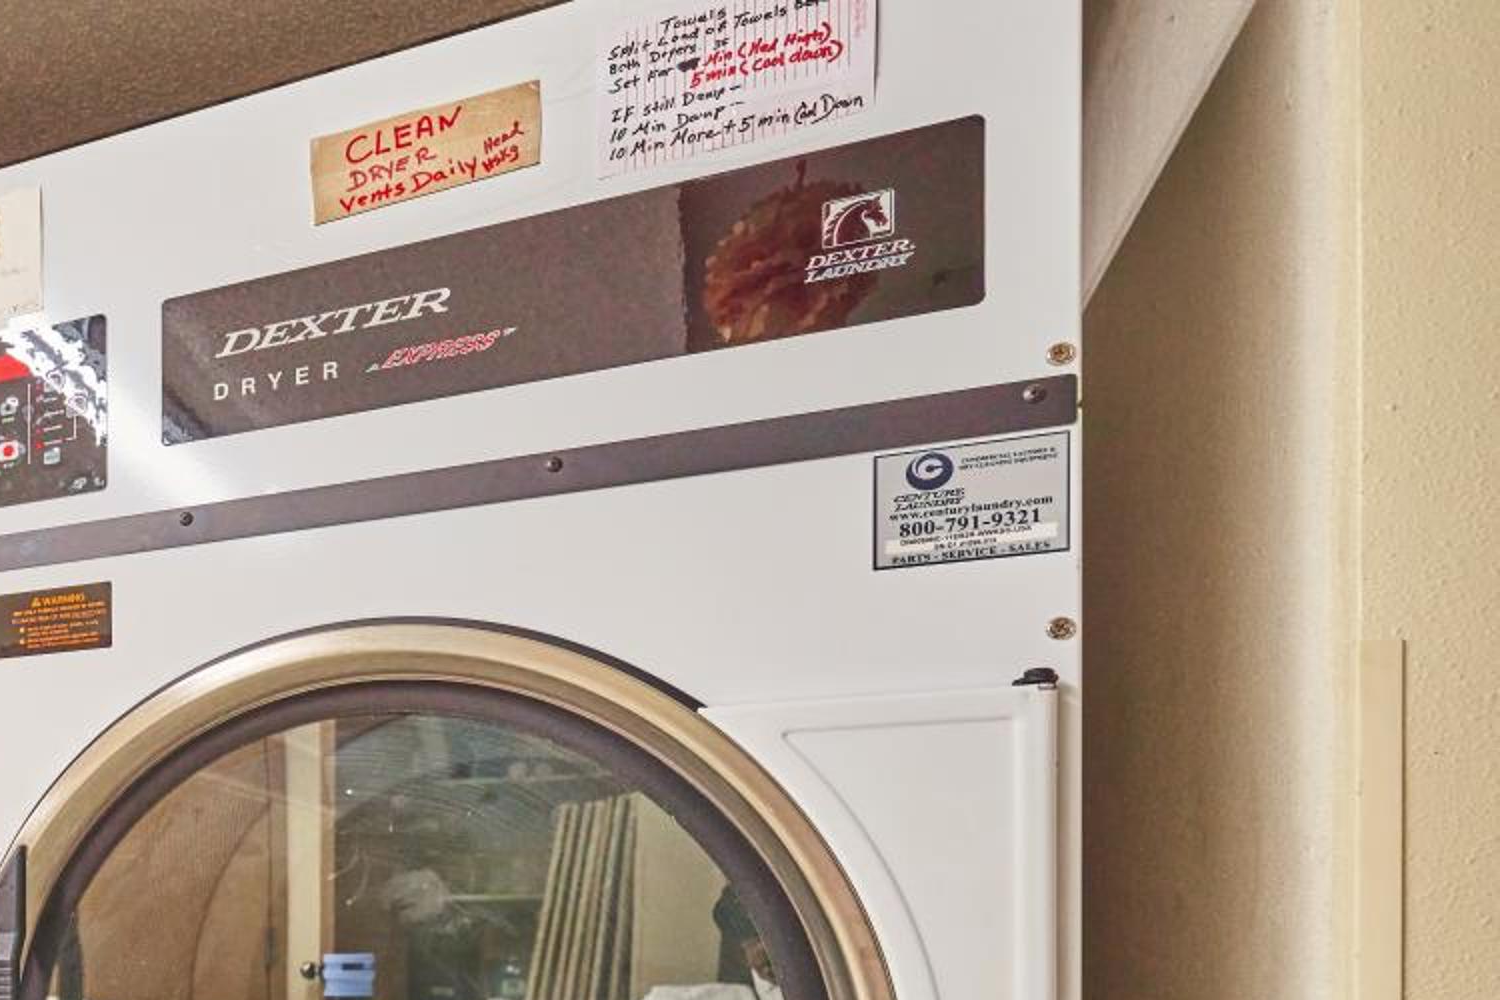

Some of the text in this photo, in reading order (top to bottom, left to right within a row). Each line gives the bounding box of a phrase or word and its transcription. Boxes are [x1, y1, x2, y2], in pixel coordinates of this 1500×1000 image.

[733, 4, 788, 30] Towels
[608, 75, 641, 95] Set
[345, 105, 463, 164] CLEAN
[609, 146, 627, 161] 10
[737, 114, 756, 133] 5
[757, 107, 792, 128] min
[346, 147, 437, 193] DRYER
[410, 154, 477, 194] Daily
[803, 251, 916, 284] LAUNDRY
[804, 239, 917, 272] DEXTER
[214, 287, 452, 360] DEXTER
[213, 328, 501, 401] DRYER EXPRESS
[889, 496, 1053, 522] www.centurylaundry.com
[899, 508, 1041, 538] 800-791-9321
